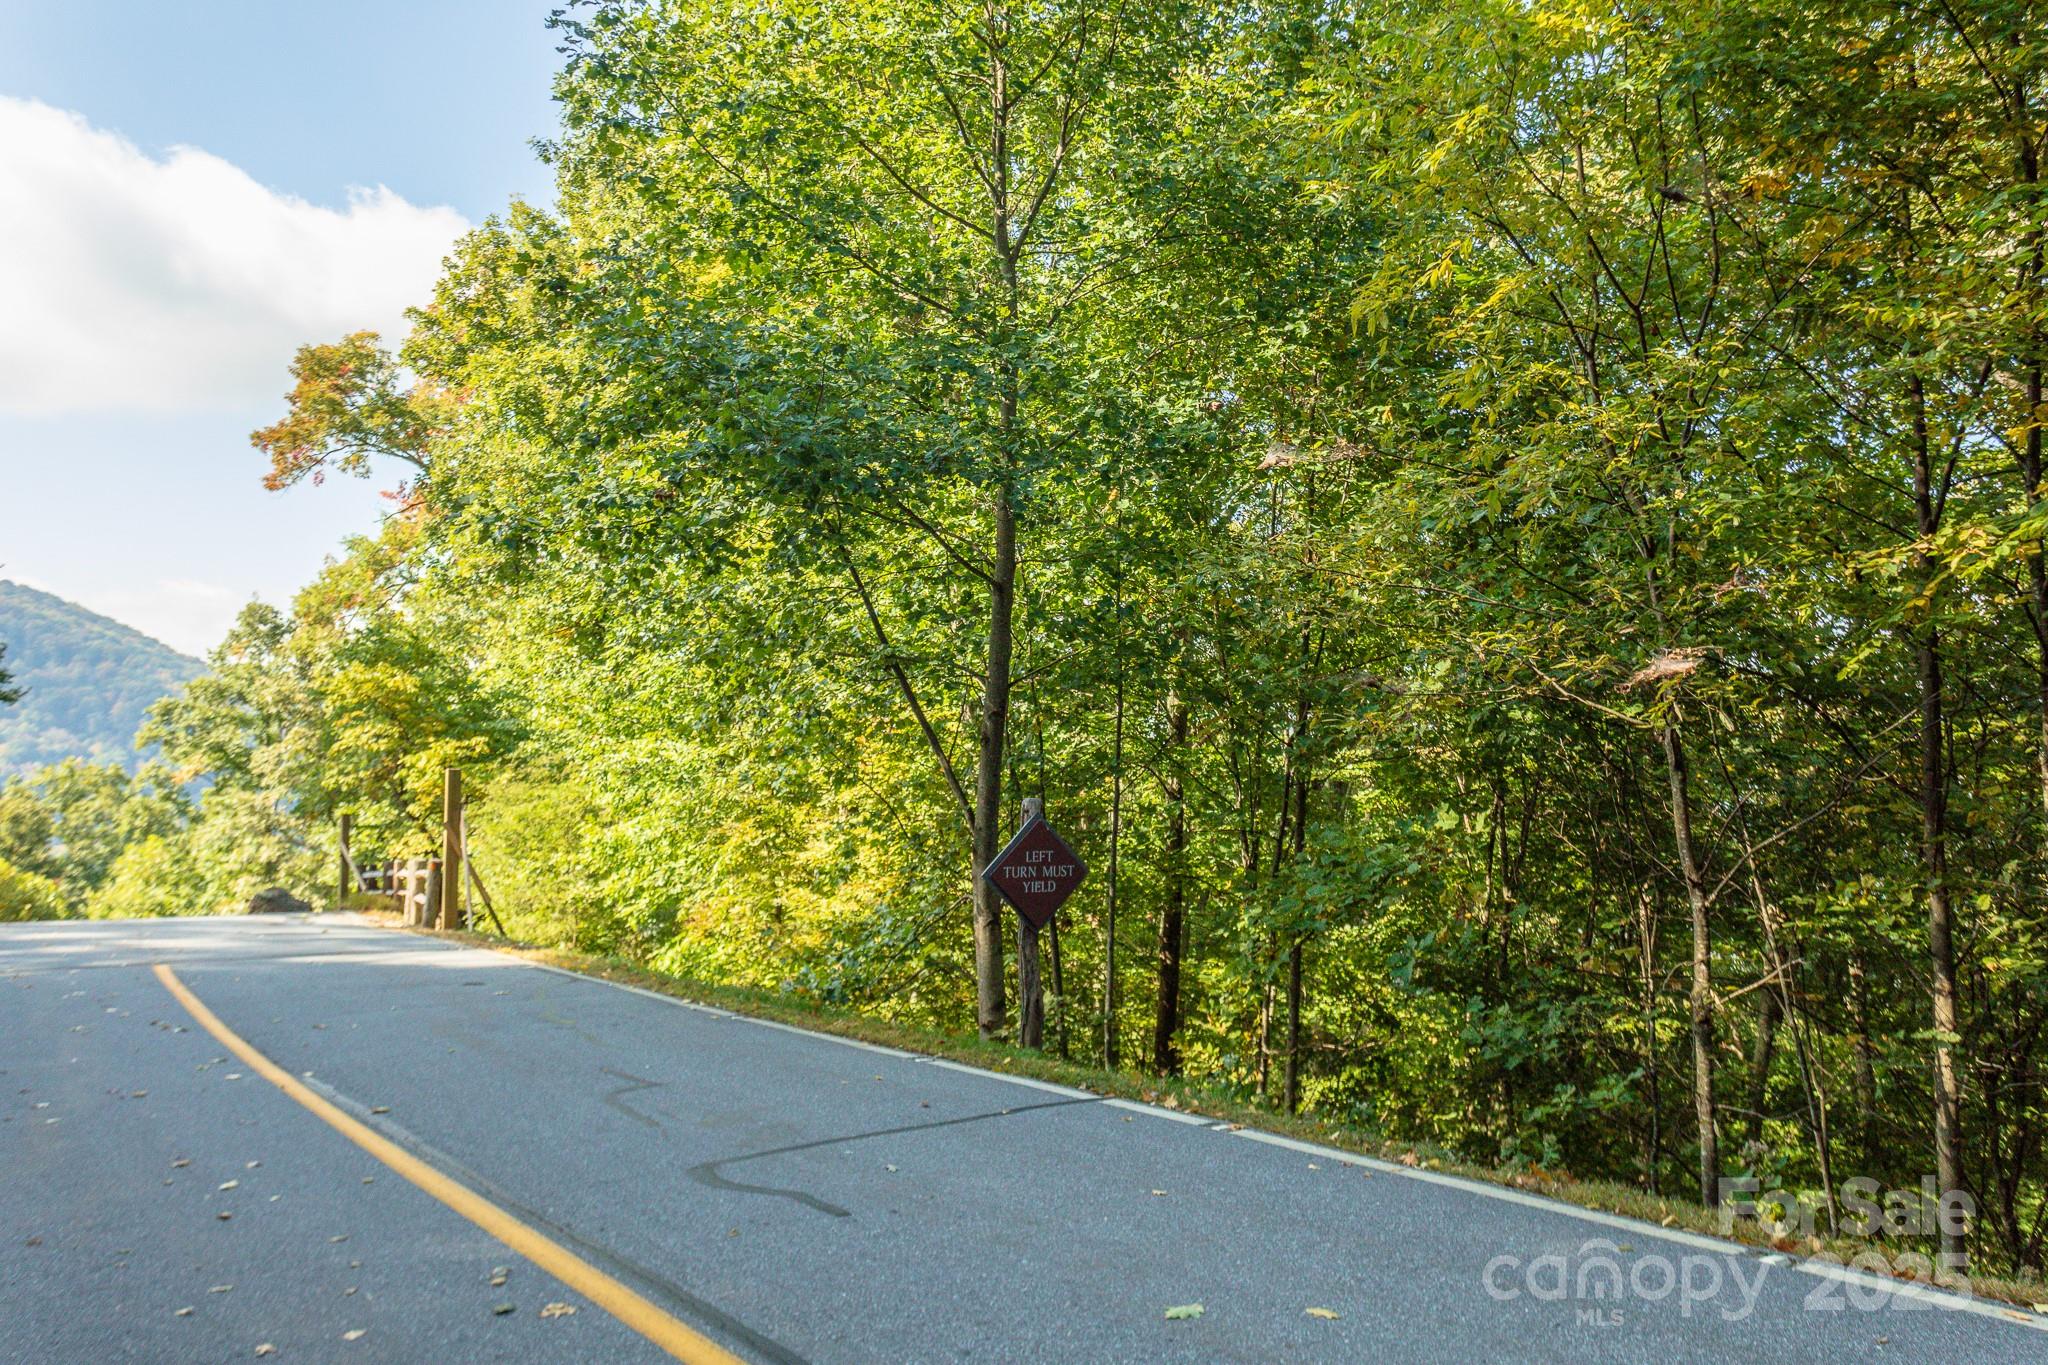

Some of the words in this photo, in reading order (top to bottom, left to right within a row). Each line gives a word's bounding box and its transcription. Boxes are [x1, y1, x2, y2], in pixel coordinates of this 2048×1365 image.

[1025, 850, 1054, 863] LEFT
[1003, 866, 1037, 879] TURN
[1042, 865, 1075, 878] MUST
[1023, 881, 1056, 893] YIELD
